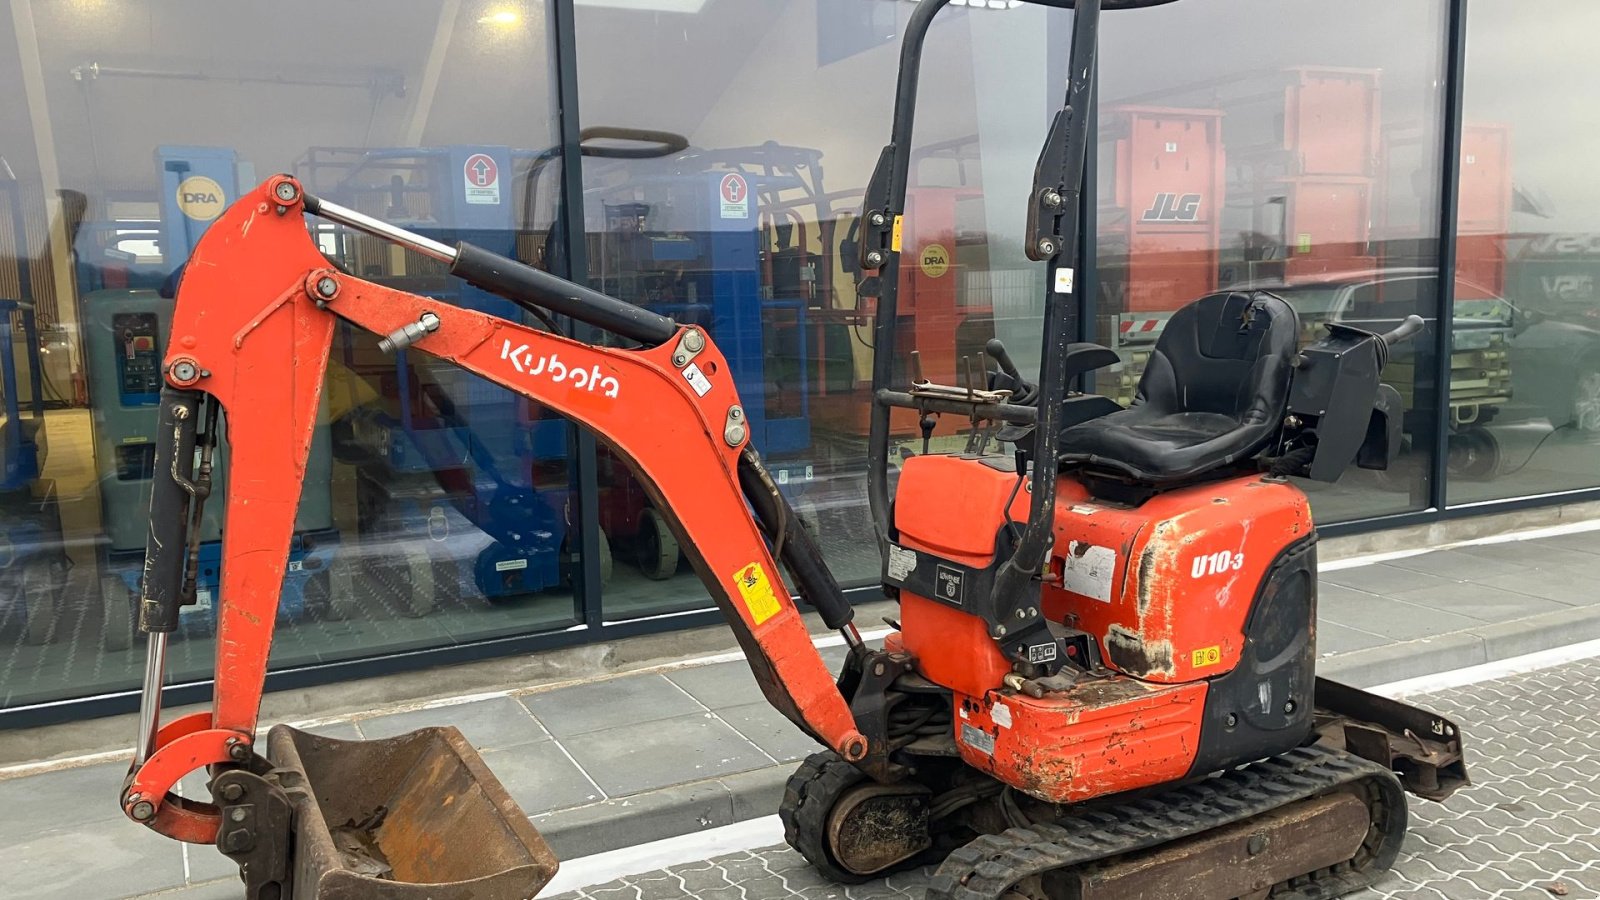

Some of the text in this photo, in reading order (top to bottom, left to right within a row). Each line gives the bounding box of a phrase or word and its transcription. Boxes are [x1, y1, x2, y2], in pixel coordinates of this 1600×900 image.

[183, 192, 218, 204] DRA
[1141, 192, 1202, 222] JLG
[924, 256, 946, 266] DRA
[500, 338, 620, 399] Kubota
[1190, 549, 1245, 579] U10-3
